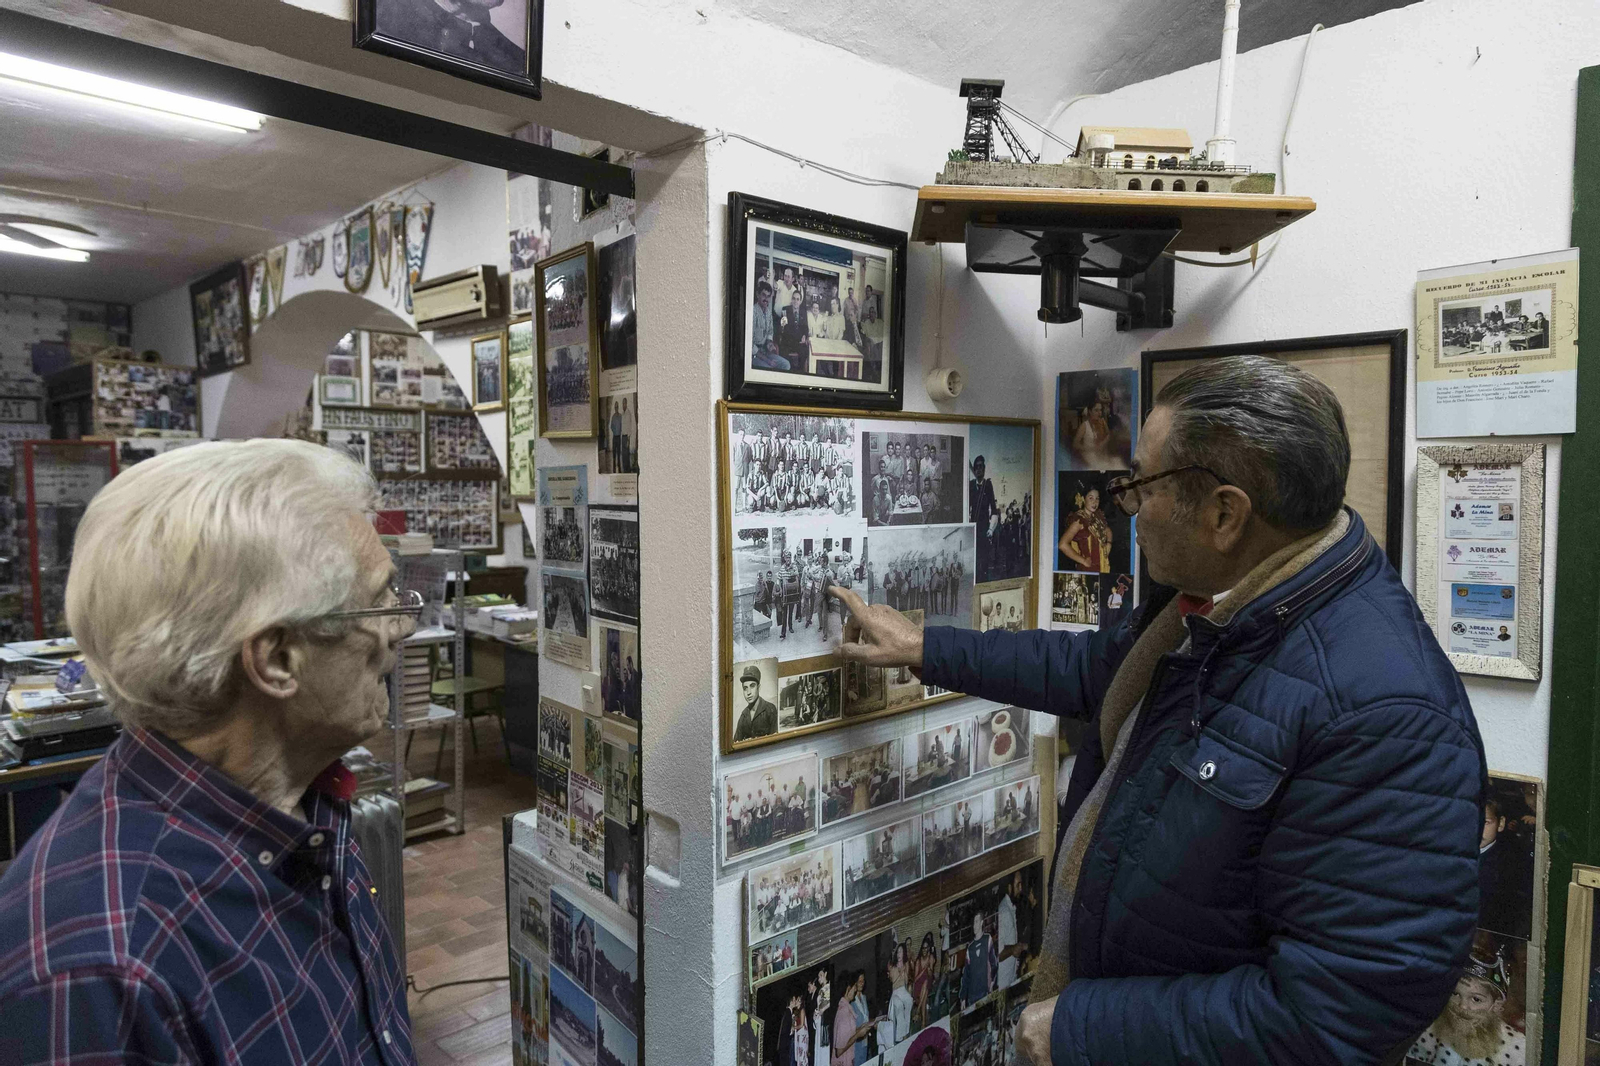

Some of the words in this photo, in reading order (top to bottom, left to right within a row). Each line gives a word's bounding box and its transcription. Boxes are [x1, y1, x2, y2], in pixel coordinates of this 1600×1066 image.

[1426, 284, 1462, 292] RECUERDO
[1492, 275, 1527, 283] INFANCIA
[1532, 269, 1566, 278] ESCOLAR
